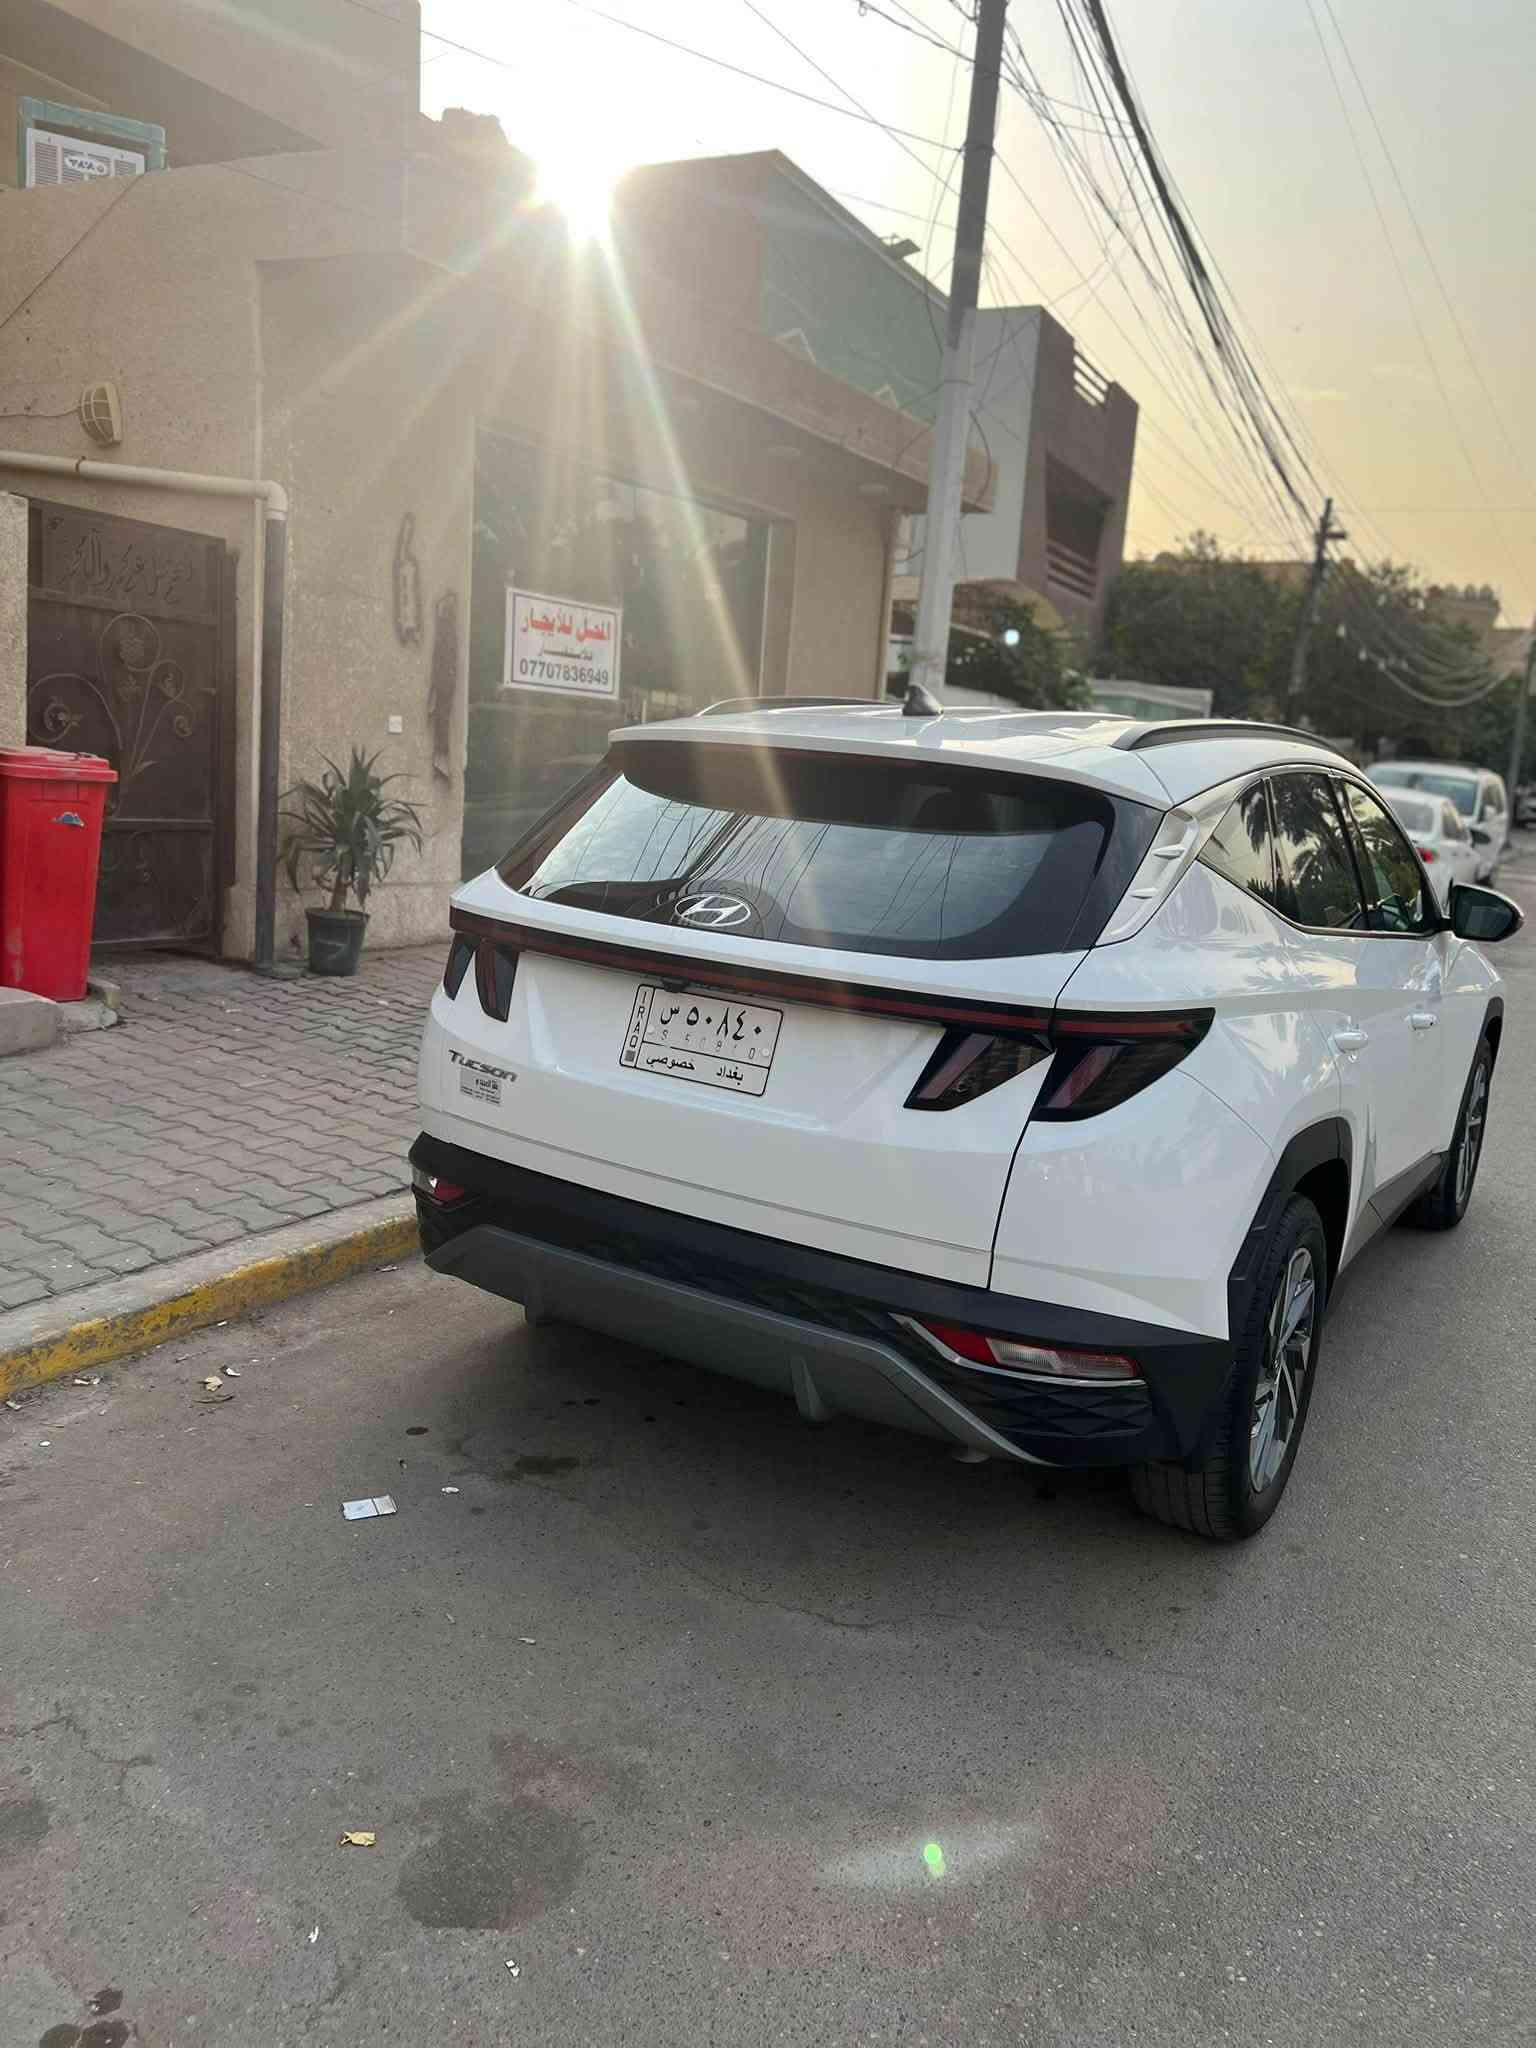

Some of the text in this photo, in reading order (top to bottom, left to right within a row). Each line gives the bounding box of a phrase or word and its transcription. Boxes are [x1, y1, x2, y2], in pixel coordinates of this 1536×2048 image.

[519, 658, 609, 685] 07707836949
[629, 991, 647, 1048] IRAQ
[660, 1006, 762, 1040] ٥٠٨٤٠ س
[646, 1054, 744, 1086] بغداد خصوصي
